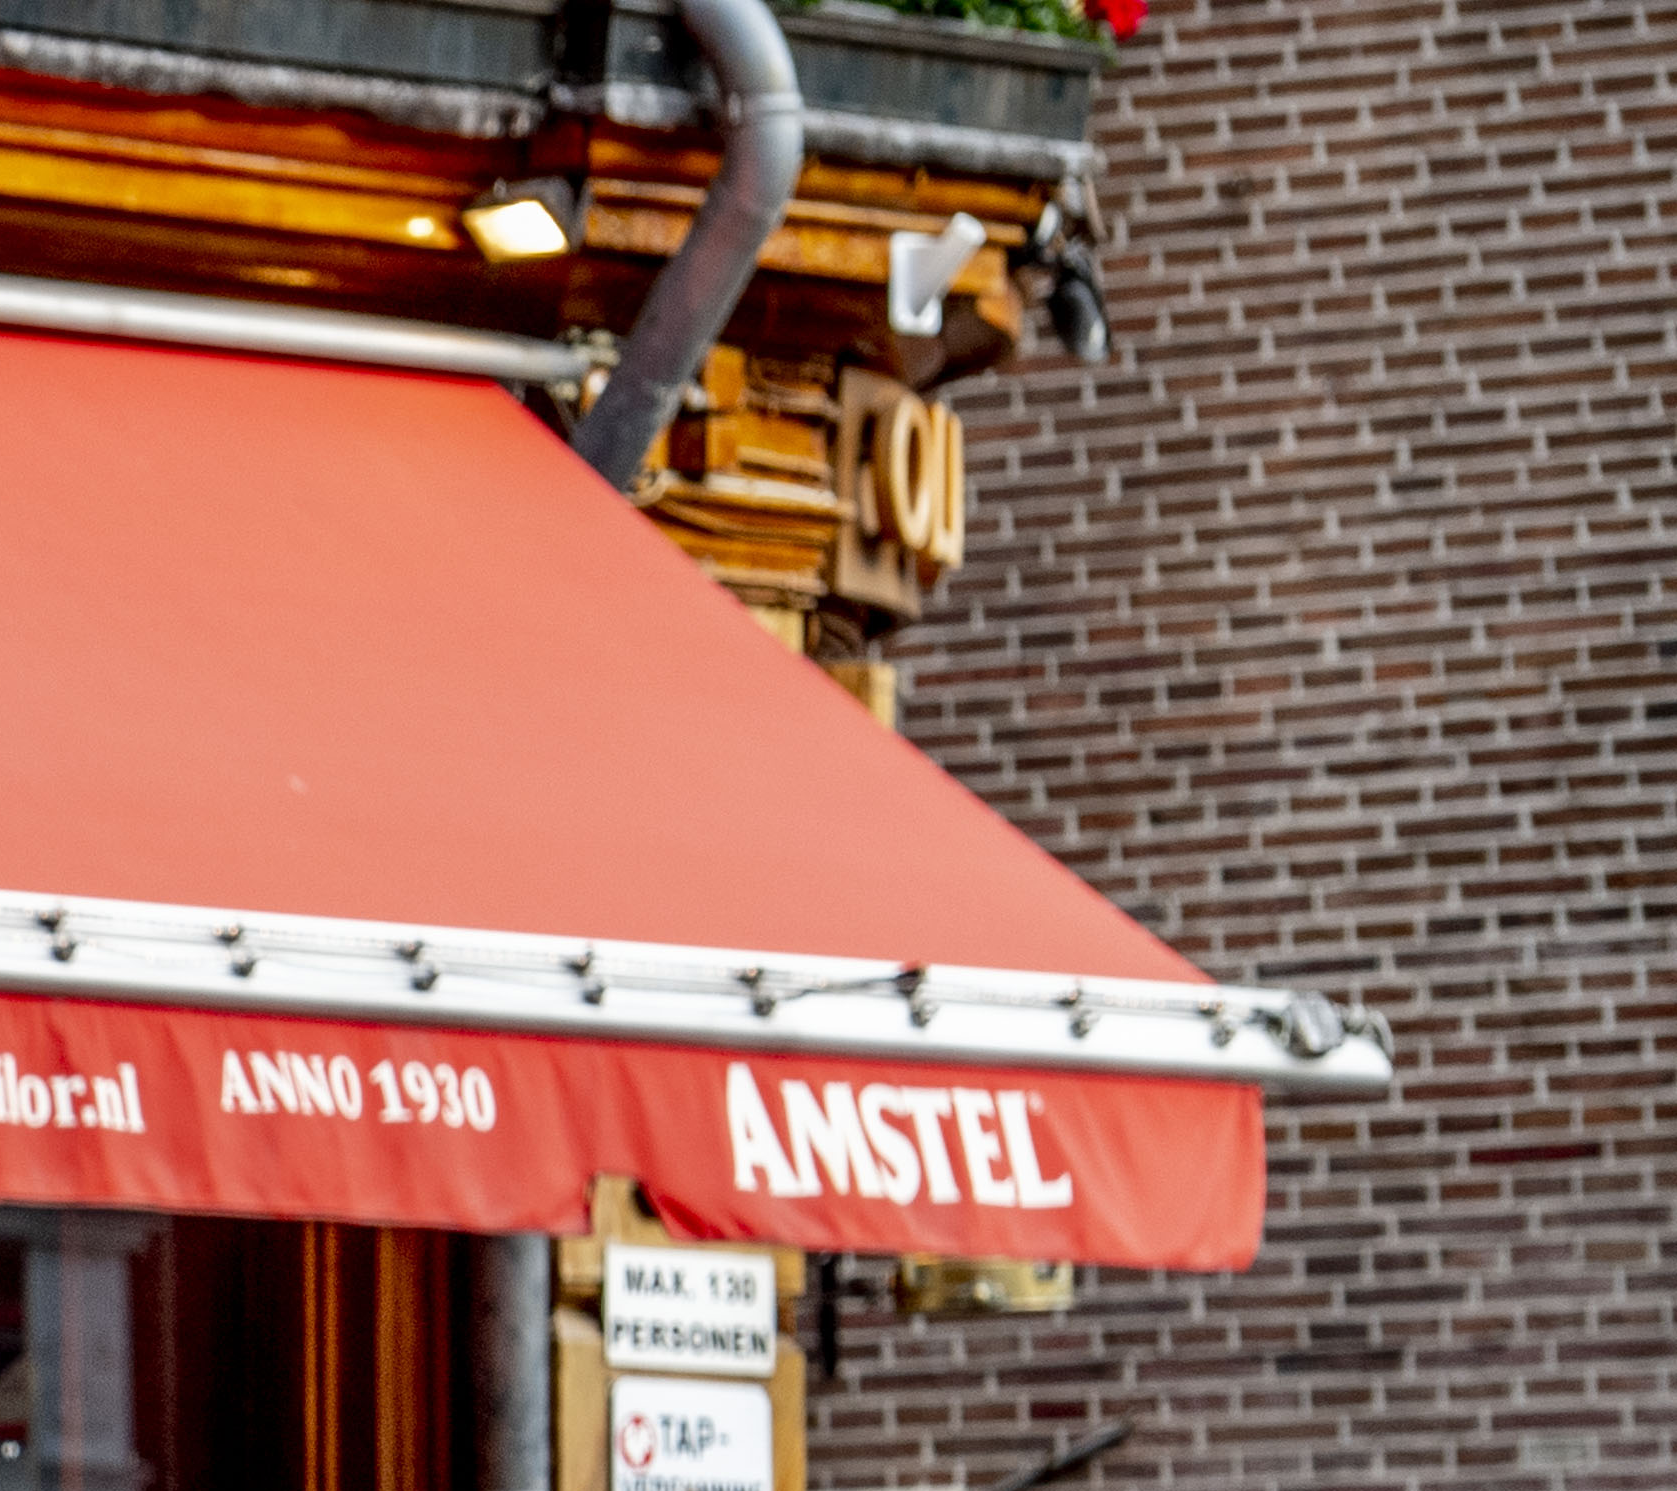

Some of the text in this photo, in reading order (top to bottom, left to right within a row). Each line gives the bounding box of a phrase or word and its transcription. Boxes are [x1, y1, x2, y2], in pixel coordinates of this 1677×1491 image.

[220, 1049, 498, 1132] ANNO 1930
[726, 1062, 1073, 1209] AMSTEL
[612, 1316, 770, 1358] PERSONEN
